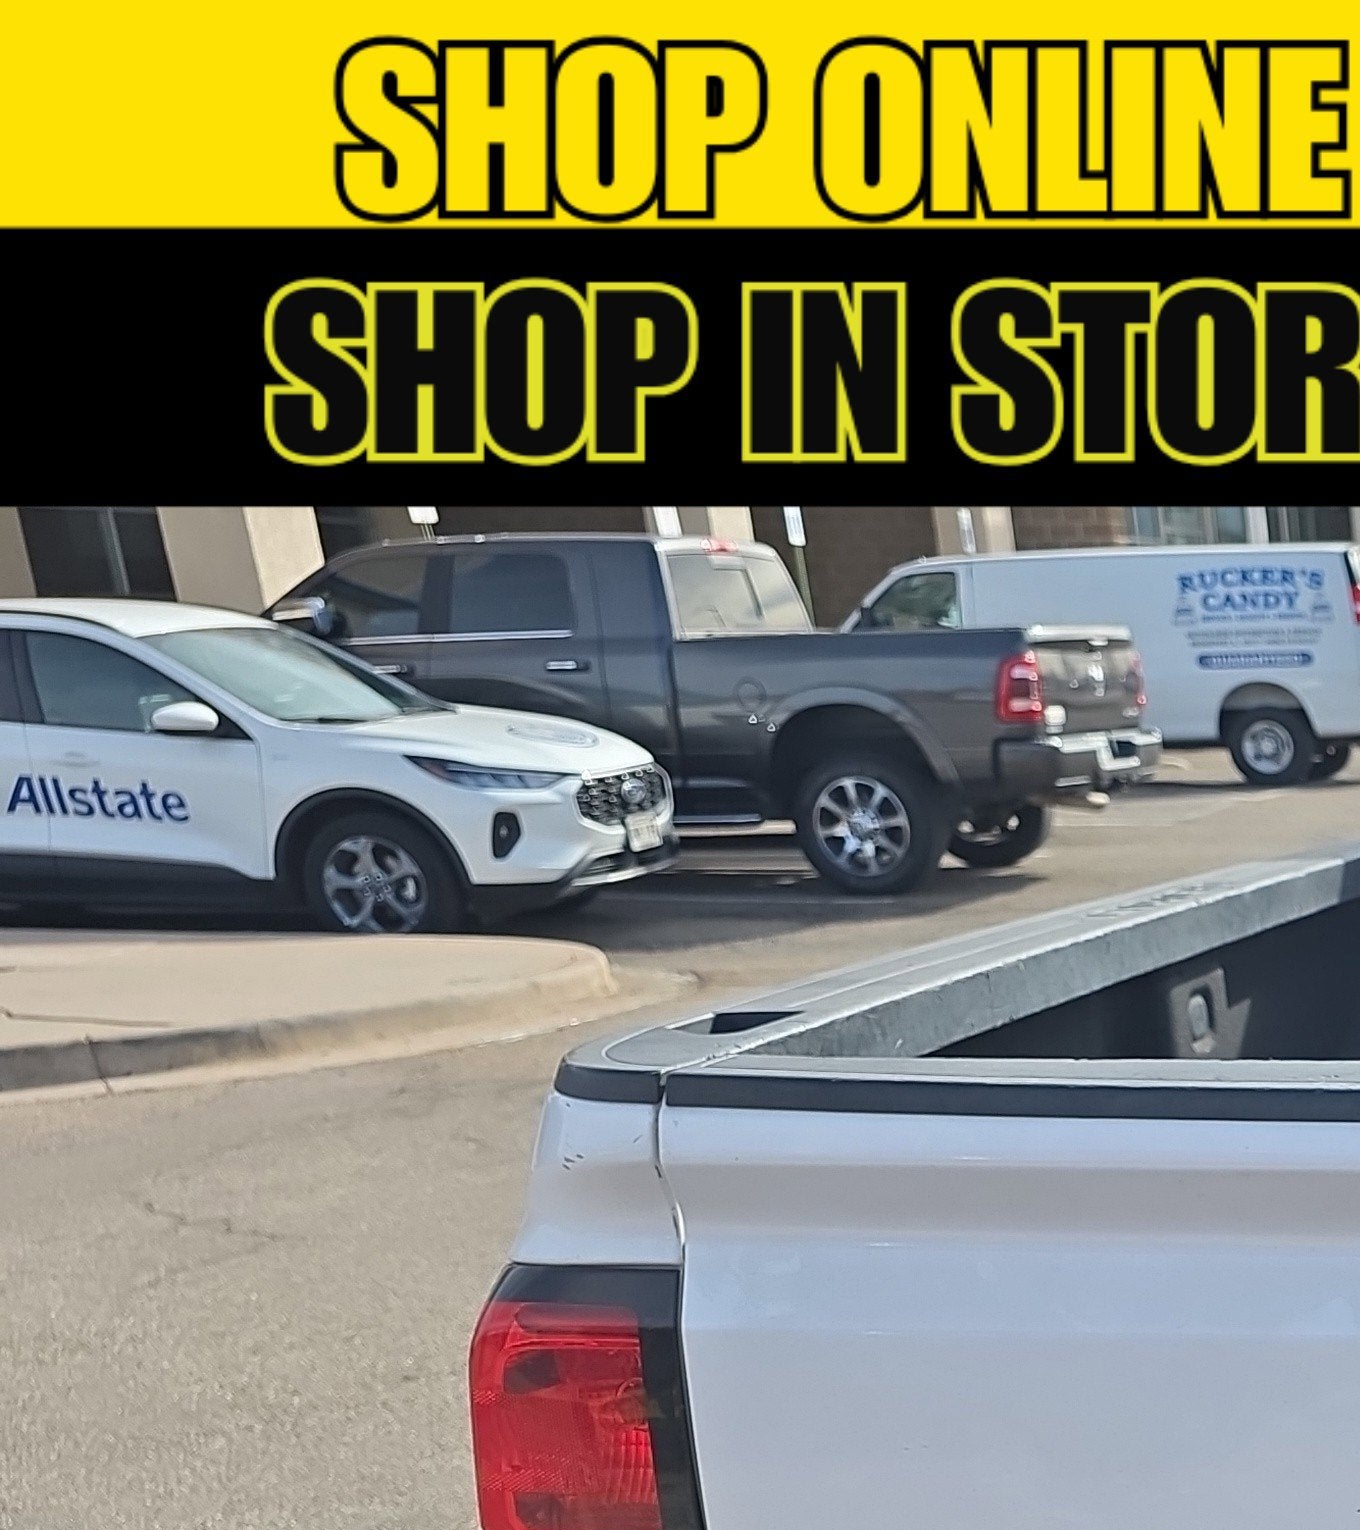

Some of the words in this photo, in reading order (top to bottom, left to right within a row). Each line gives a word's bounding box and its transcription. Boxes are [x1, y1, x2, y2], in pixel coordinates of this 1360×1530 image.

[1178, 567, 1324, 594] RUCKER'S
[1203, 592, 1299, 612] CANDY
[7, 775, 190, 822] Allstate
